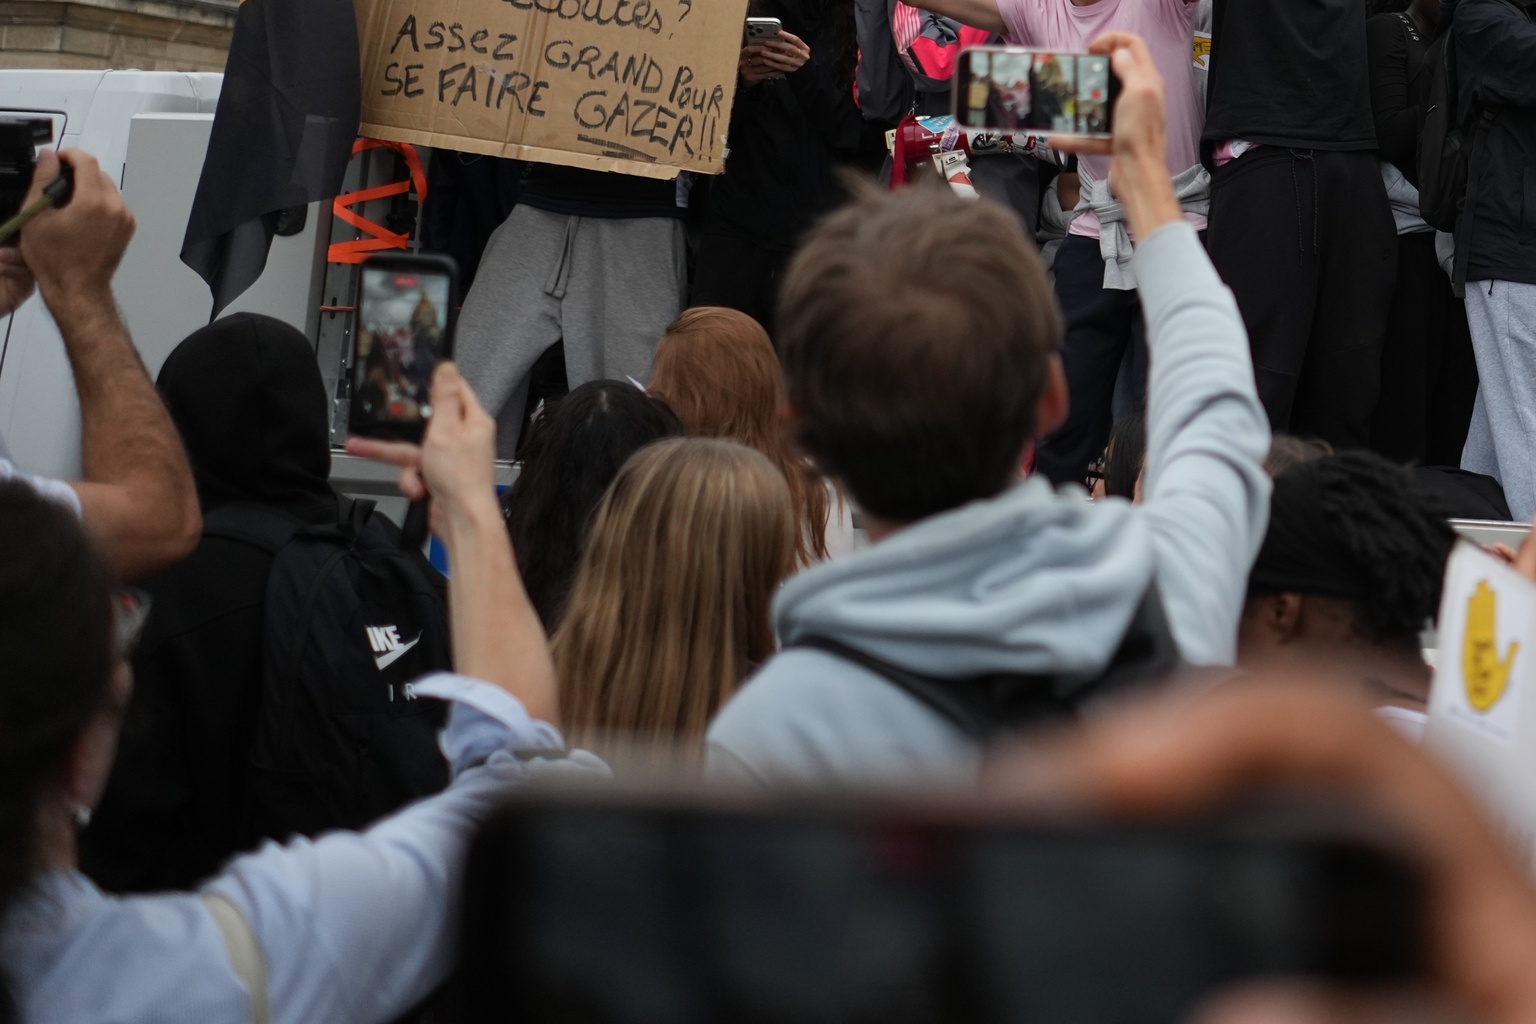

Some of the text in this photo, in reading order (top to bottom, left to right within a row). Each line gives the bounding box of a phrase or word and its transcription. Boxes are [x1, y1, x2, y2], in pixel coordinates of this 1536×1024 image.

[381, 62, 425, 98] SE
[437, 62, 550, 117] FAIRE
[544, 39, 664, 94] GRAND
[365, 624, 405, 652] IKE
